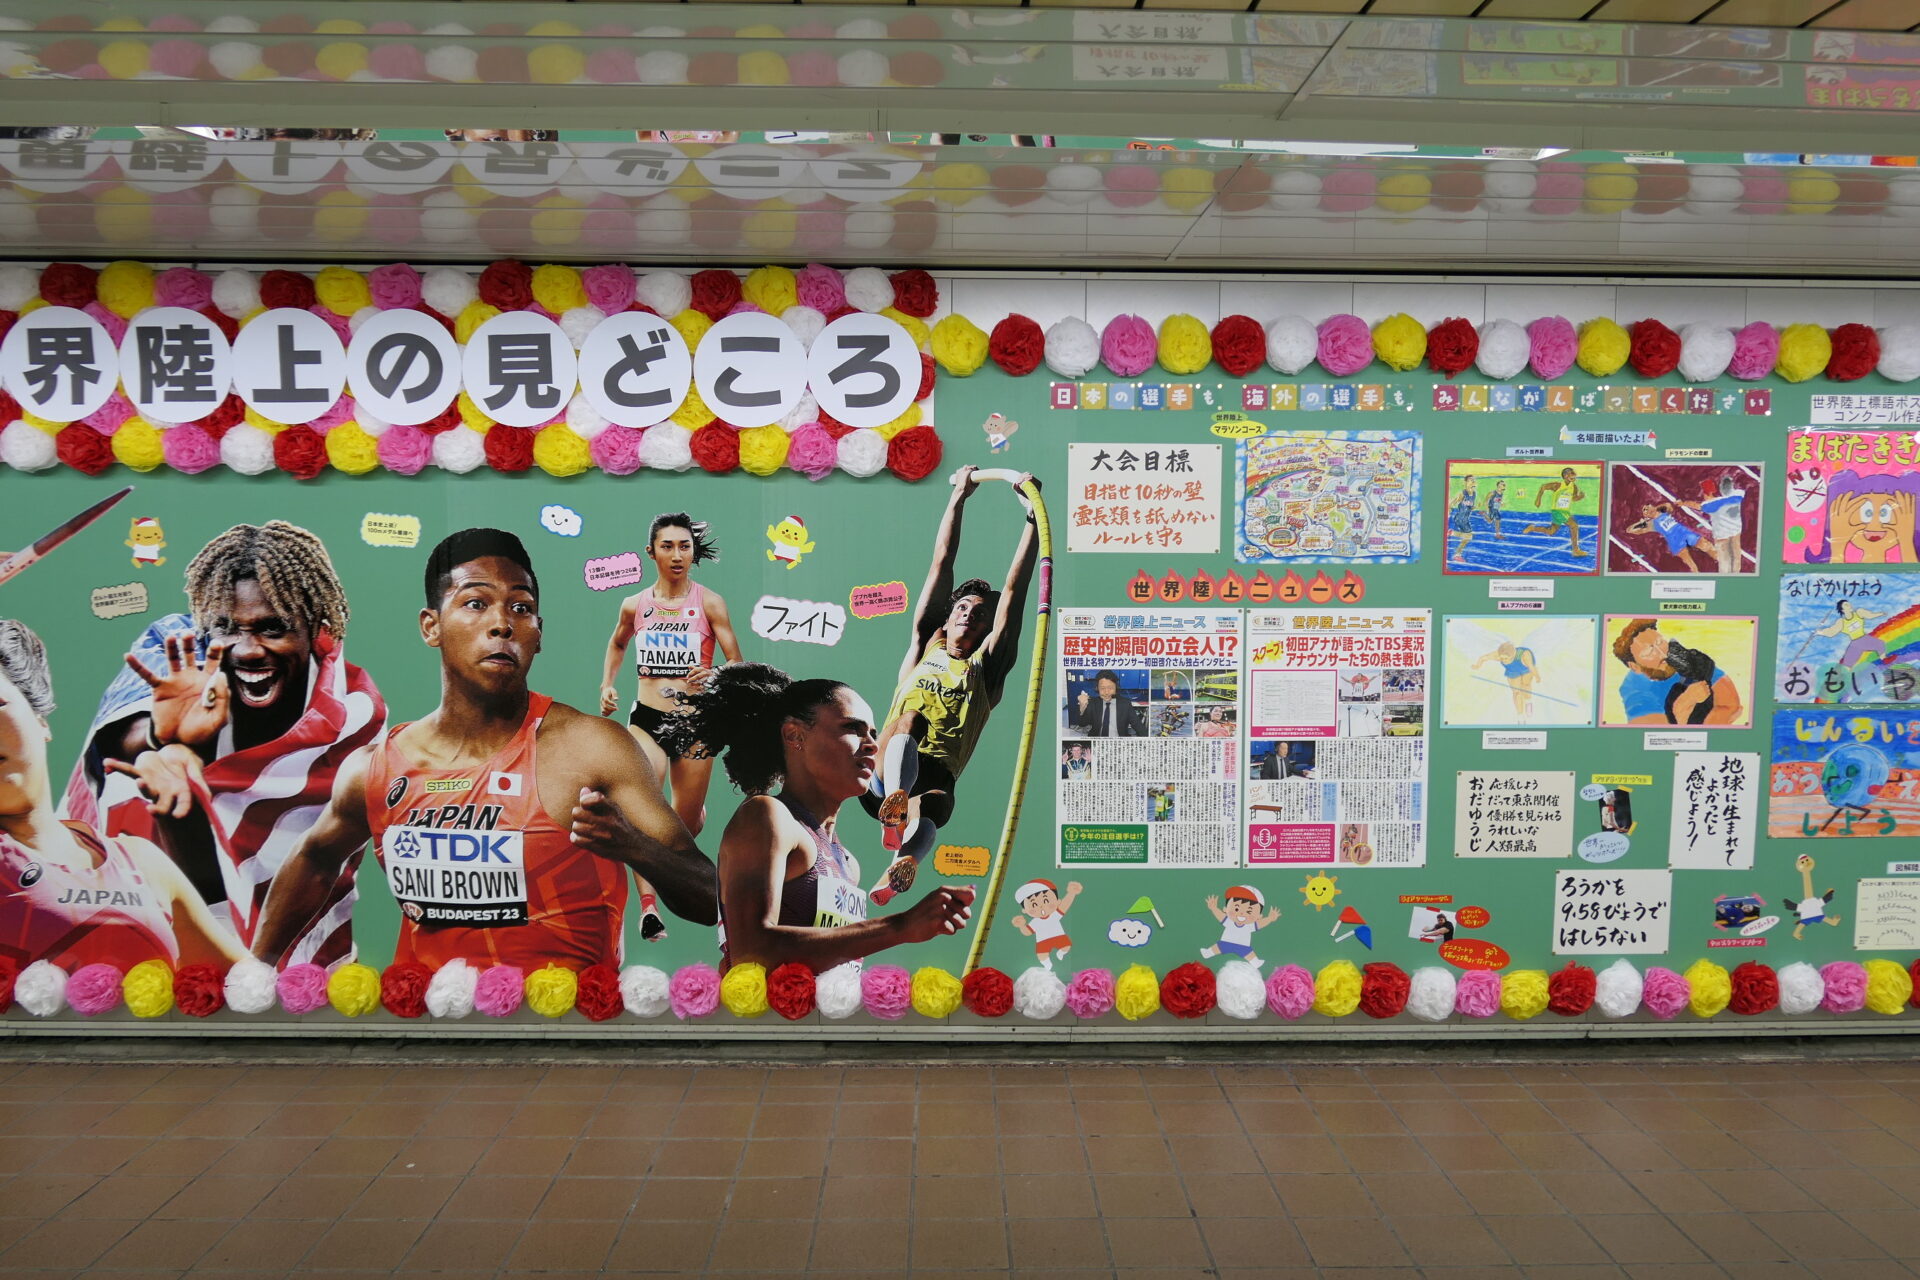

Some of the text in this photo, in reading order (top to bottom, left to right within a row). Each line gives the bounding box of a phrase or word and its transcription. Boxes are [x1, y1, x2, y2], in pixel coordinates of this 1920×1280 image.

[23, 324, 912, 410] 界陸上の見どころ
[1057, 387, 1214, 405] 日本の選手も
[1246, 385, 1405, 405] 海外の選手も
[1437, 389, 1764, 410] みんながんばってください
[1214, 425, 1262, 434] マラソンコース
[1791, 432, 1920, 465] まばたきき
[1090, 449, 1194, 473] 大会目標
[1084, 480, 1205, 502] 目指せ10秒の壁
[1072, 505, 1215, 527] 霊長類を舐めない
[1093, 525, 1183, 548] ルールを守る
[1133, 579, 1357, 599] 世界陸上ニュース
[1786, 578, 1883, 598] なげかけよう
[647, 622, 690, 632] JAPAN
[763, 605, 839, 642] ファイト
[1103, 615, 1207, 629] 世界陸上ニュース
[1292, 616, 1395, 630] 世界陸上ニュース
[645, 632, 688, 649] NTN
[1286, 636, 1425, 652] 初田アナが語ったTBS実況
[640, 649, 697, 665] TANAKA
[1286, 652, 1425, 668] アナウンサーたちの熱き戦い
[426, 779, 472, 792] SEIKO
[1490, 777, 1539, 791] 応援しよう
[1703, 778, 1721, 836] よかったと
[1719, 755, 1745, 867] 地球に生まれて
[1488, 824, 1540, 836] うれしいな
[420, 832, 513, 863] TDK
[1485, 839, 1537, 853] 人類最高
[393, 865, 519, 899] SANI BROWN
[1561, 876, 1626, 898] ろうかを
[58, 888, 145, 907] JAPAN
[426, 907, 520, 921] BUDAPEST 23
[1560, 927, 1647, 947] はしらない
